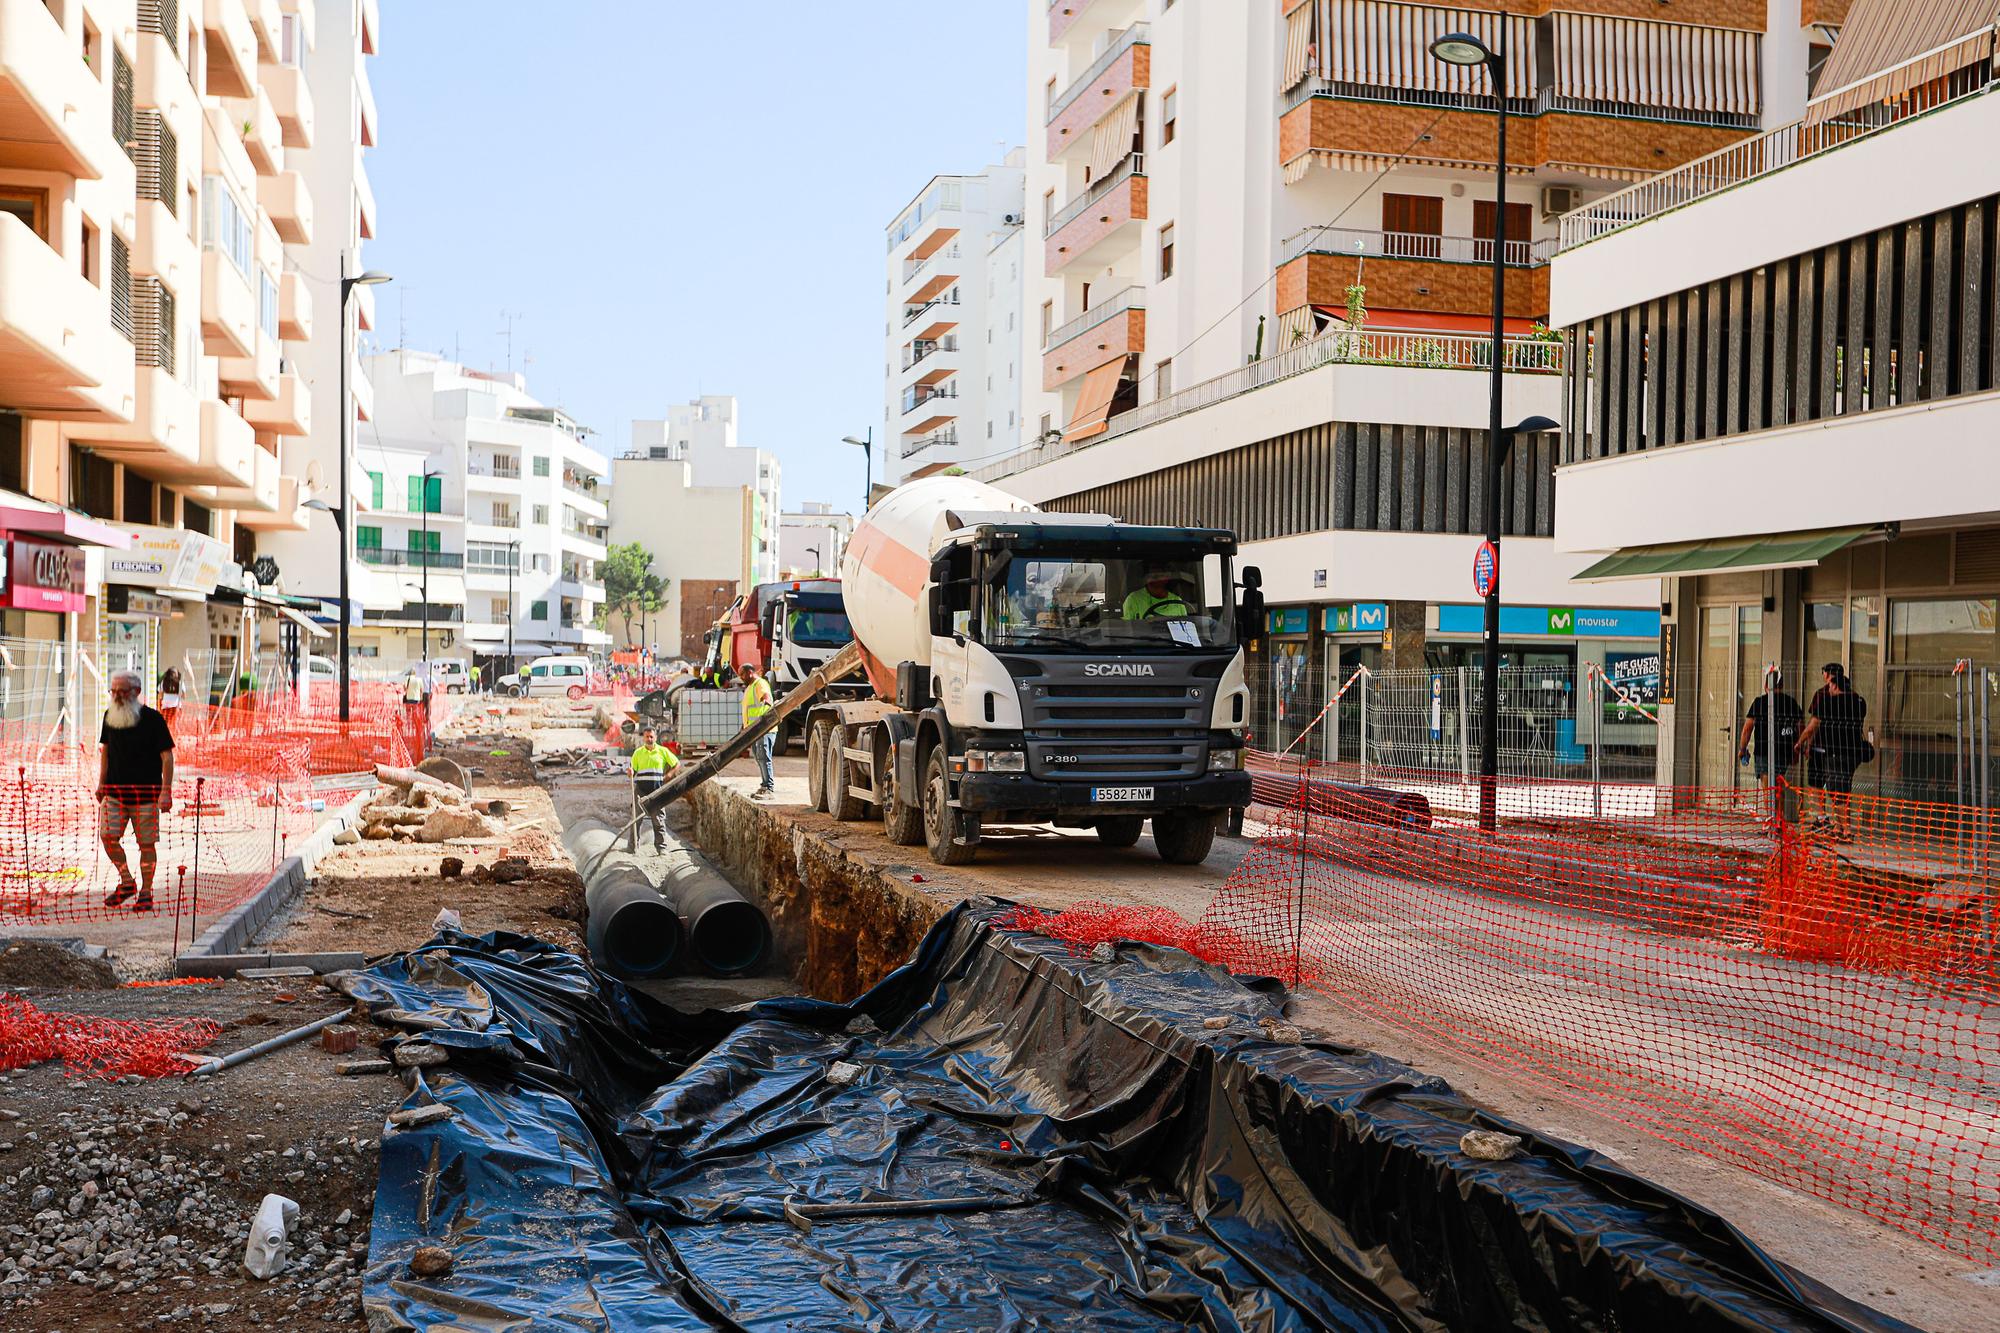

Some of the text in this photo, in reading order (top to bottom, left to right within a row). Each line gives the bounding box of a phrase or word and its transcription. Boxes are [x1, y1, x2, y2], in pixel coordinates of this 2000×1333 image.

[112, 561, 162, 574] EURONICS
[1577, 617, 1619, 628] movistar
[1615, 656, 1659, 671] ME GUSTA
[1084, 663, 1155, 677] SCANIA
[1615, 670, 1625, 679] EL
[1045, 755, 1078, 763] P 380
[1098, 788, 1152, 800] 5582 FNW
